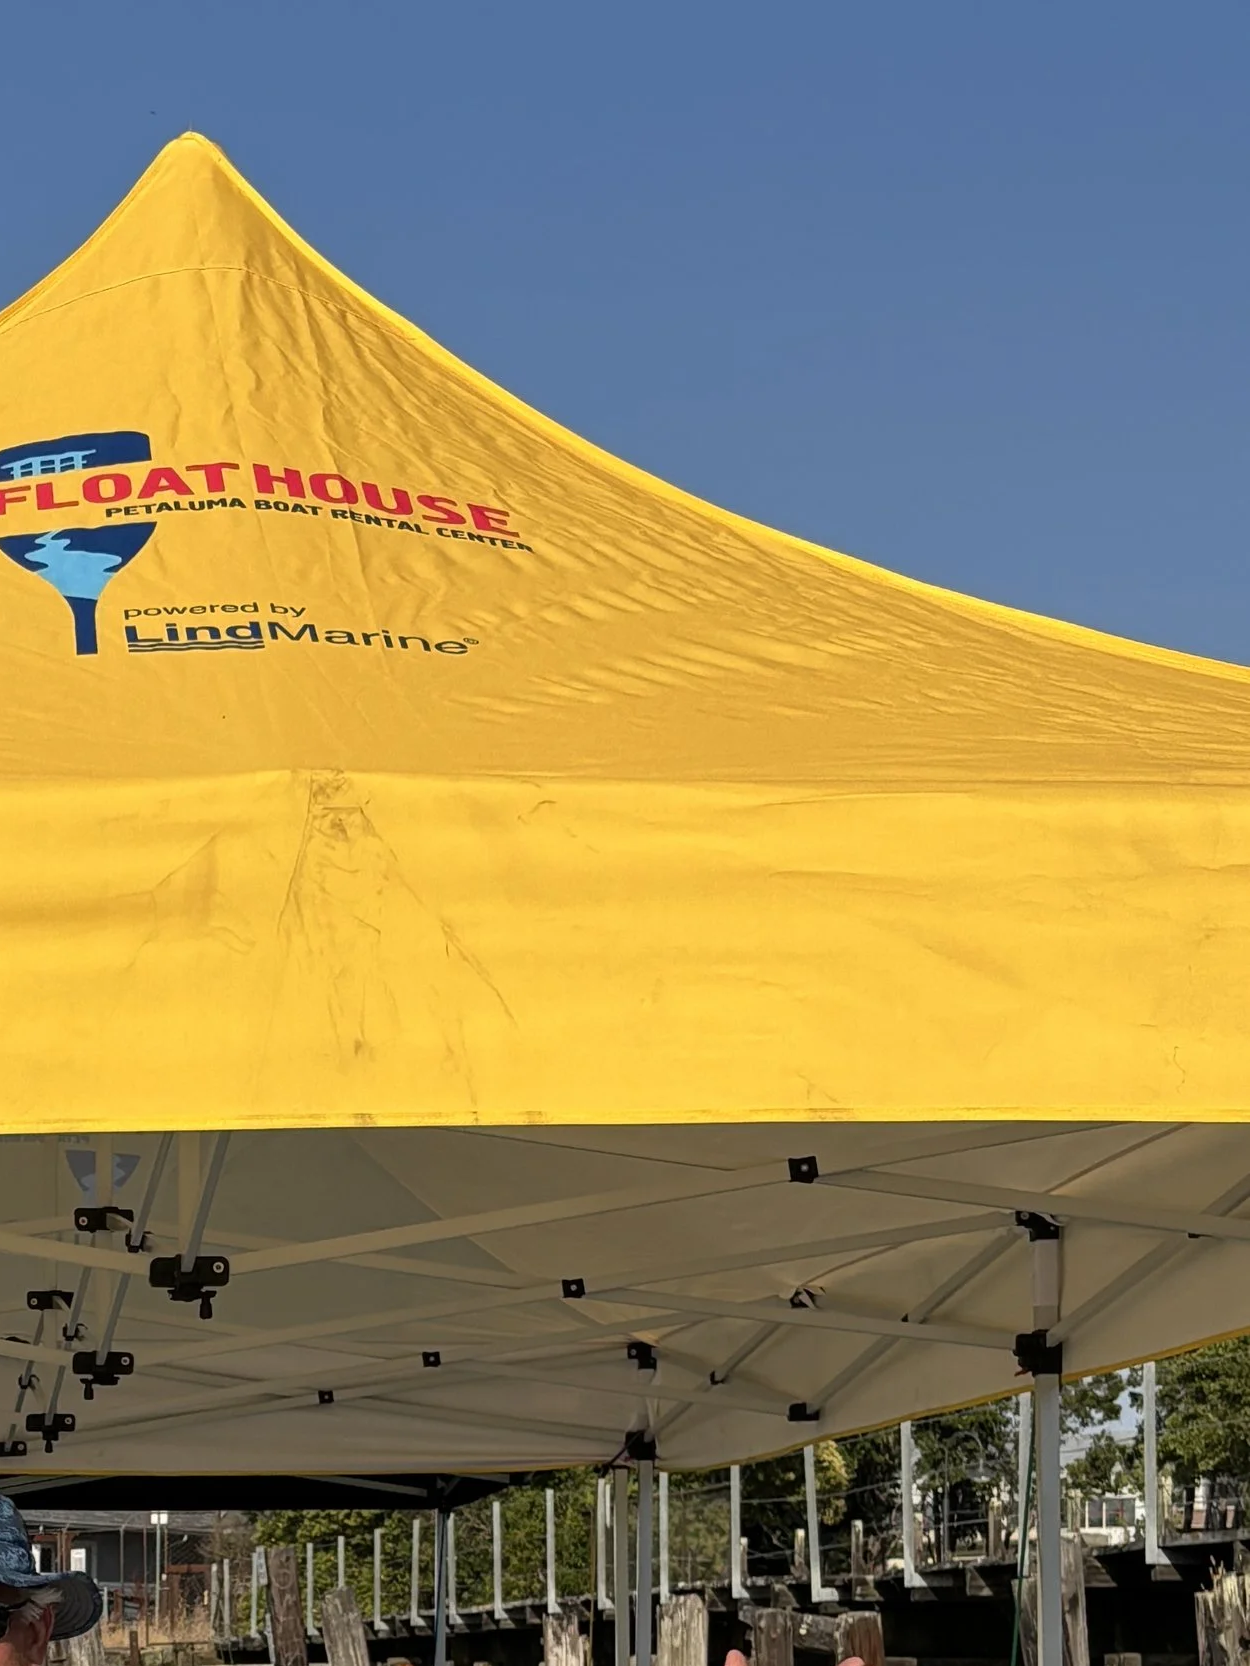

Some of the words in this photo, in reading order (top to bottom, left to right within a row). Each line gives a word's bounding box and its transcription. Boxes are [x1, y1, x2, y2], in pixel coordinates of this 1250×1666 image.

[105, 497, 247, 518] PETALUMA
[254, 499, 323, 517] BOAT
[331, 508, 430, 535] RENTAL
[435, 526, 535, 554] CENTER
[252, 463, 521, 538] HOUSE
[123, 601, 259, 620] powered
[269, 602, 306, 618] by
